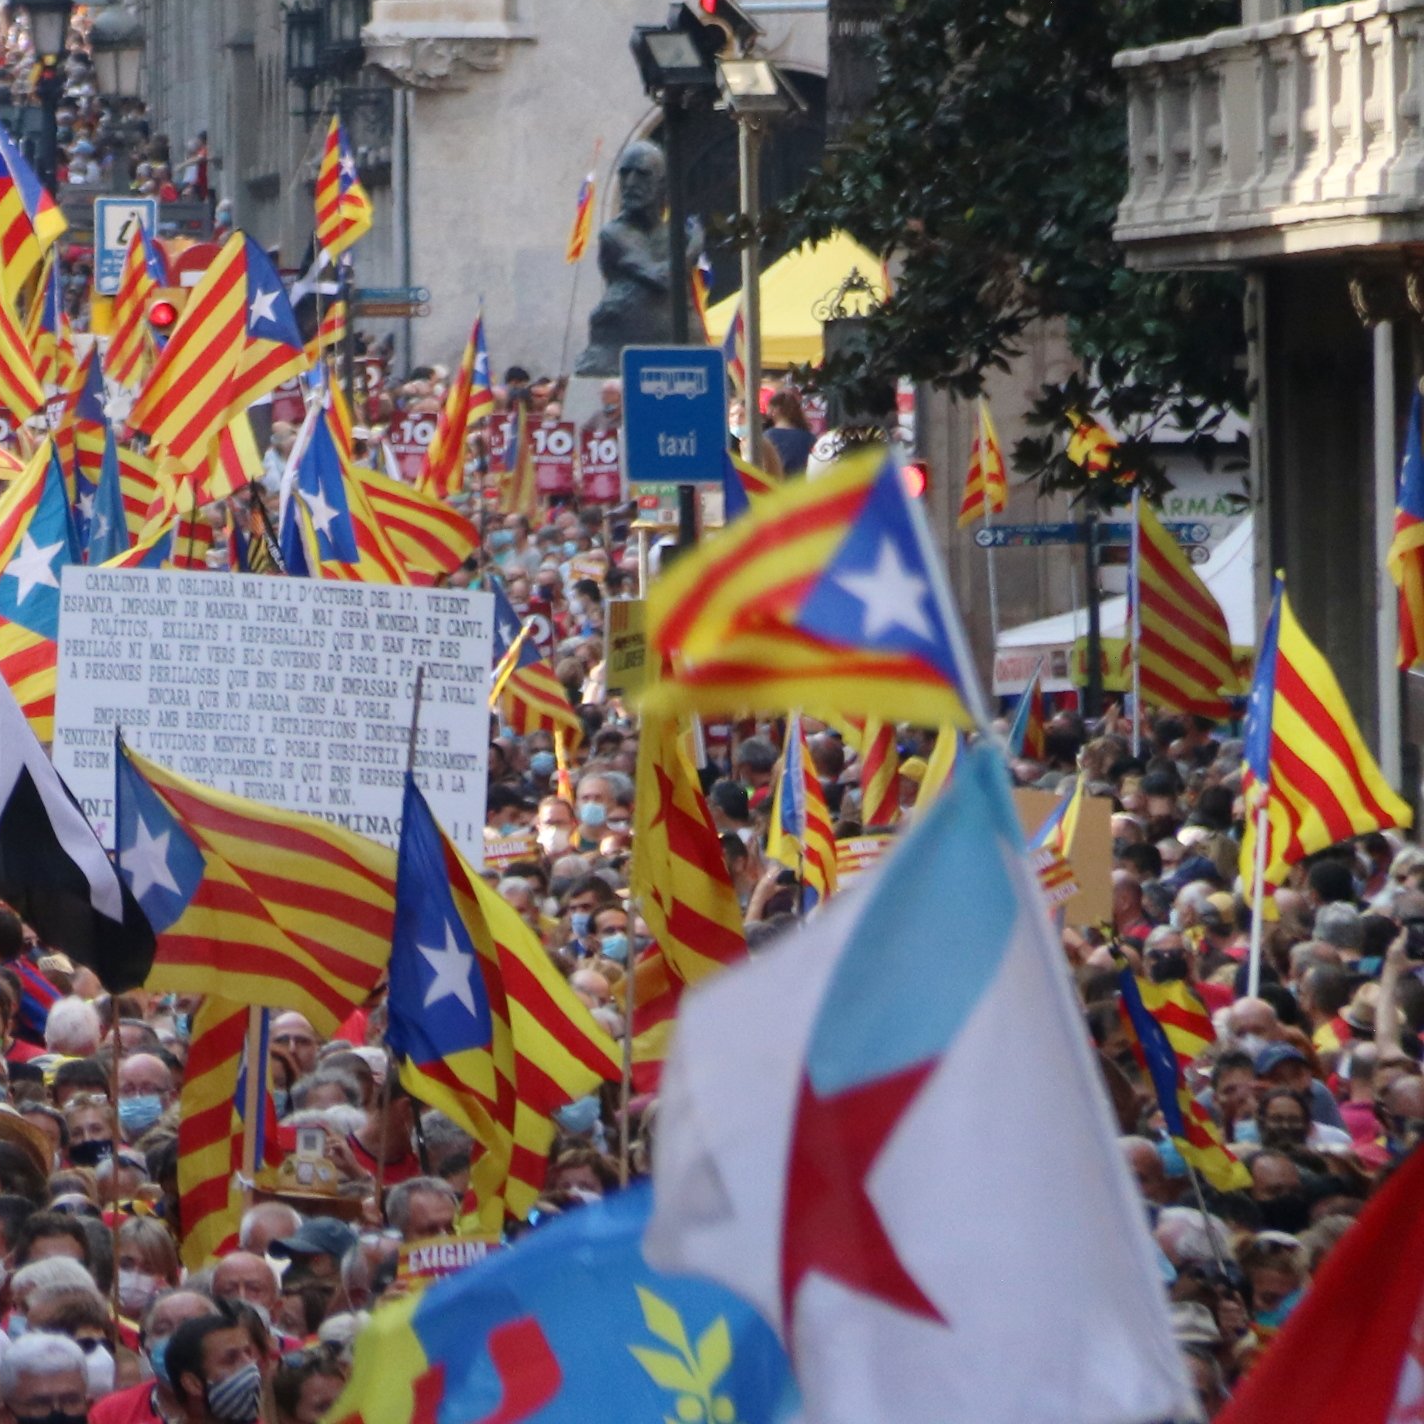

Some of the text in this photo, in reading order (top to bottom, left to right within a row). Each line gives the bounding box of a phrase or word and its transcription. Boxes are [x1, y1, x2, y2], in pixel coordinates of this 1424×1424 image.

[657, 430, 697, 457] taxi
[86, 574, 150, 593] CATALUNYA
[157, 577, 171, 594] NO
[178, 575, 234, 597] OBLIDARÀ
[242, 581, 262, 599] MAI
[370, 592, 391, 608] DEL
[427, 596, 470, 615] VEIENT
[64, 595, 113, 614] ESPANYA
[184, 601, 199, 617] DE
[312, 608, 332, 626] MAI
[341, 607, 368, 628] SERÀ
[376, 614, 418, 633] MONEDA
[426, 618, 440, 634] DE
[332, 631, 355, 652] QUE
[362, 635, 376, 651] NO
[129, 642, 142, 659] NI
[207, 647, 235, 663] VERS
[242, 648, 264, 665] ELS
[328, 654, 342, 671] DE
[227, 669, 248, 689] QUE
[256, 672, 276, 689] ENS
[285, 674, 305, 691] LES
[314, 676, 334, 693] FAN
[405, 683, 434, 701] CLL
[149, 689, 190, 707] ENCARA
[198, 690, 219, 710] QUE
[227, 693, 240, 708] NO
[248, 695, 290, 714] AGRADA
[297, 697, 326, 714] GENS
[333, 699, 348, 716] AL
[158, 710, 179, 727] AMB
[285, 740, 321, 759] POBLE
[408, 750, 483, 772] ENOSAMENT.
[280, 762, 294, 779] DE
[301, 763, 322, 783] QUI
[307, 787, 321, 803] AL
[409, 1241, 487, 1273] EXIGIM
